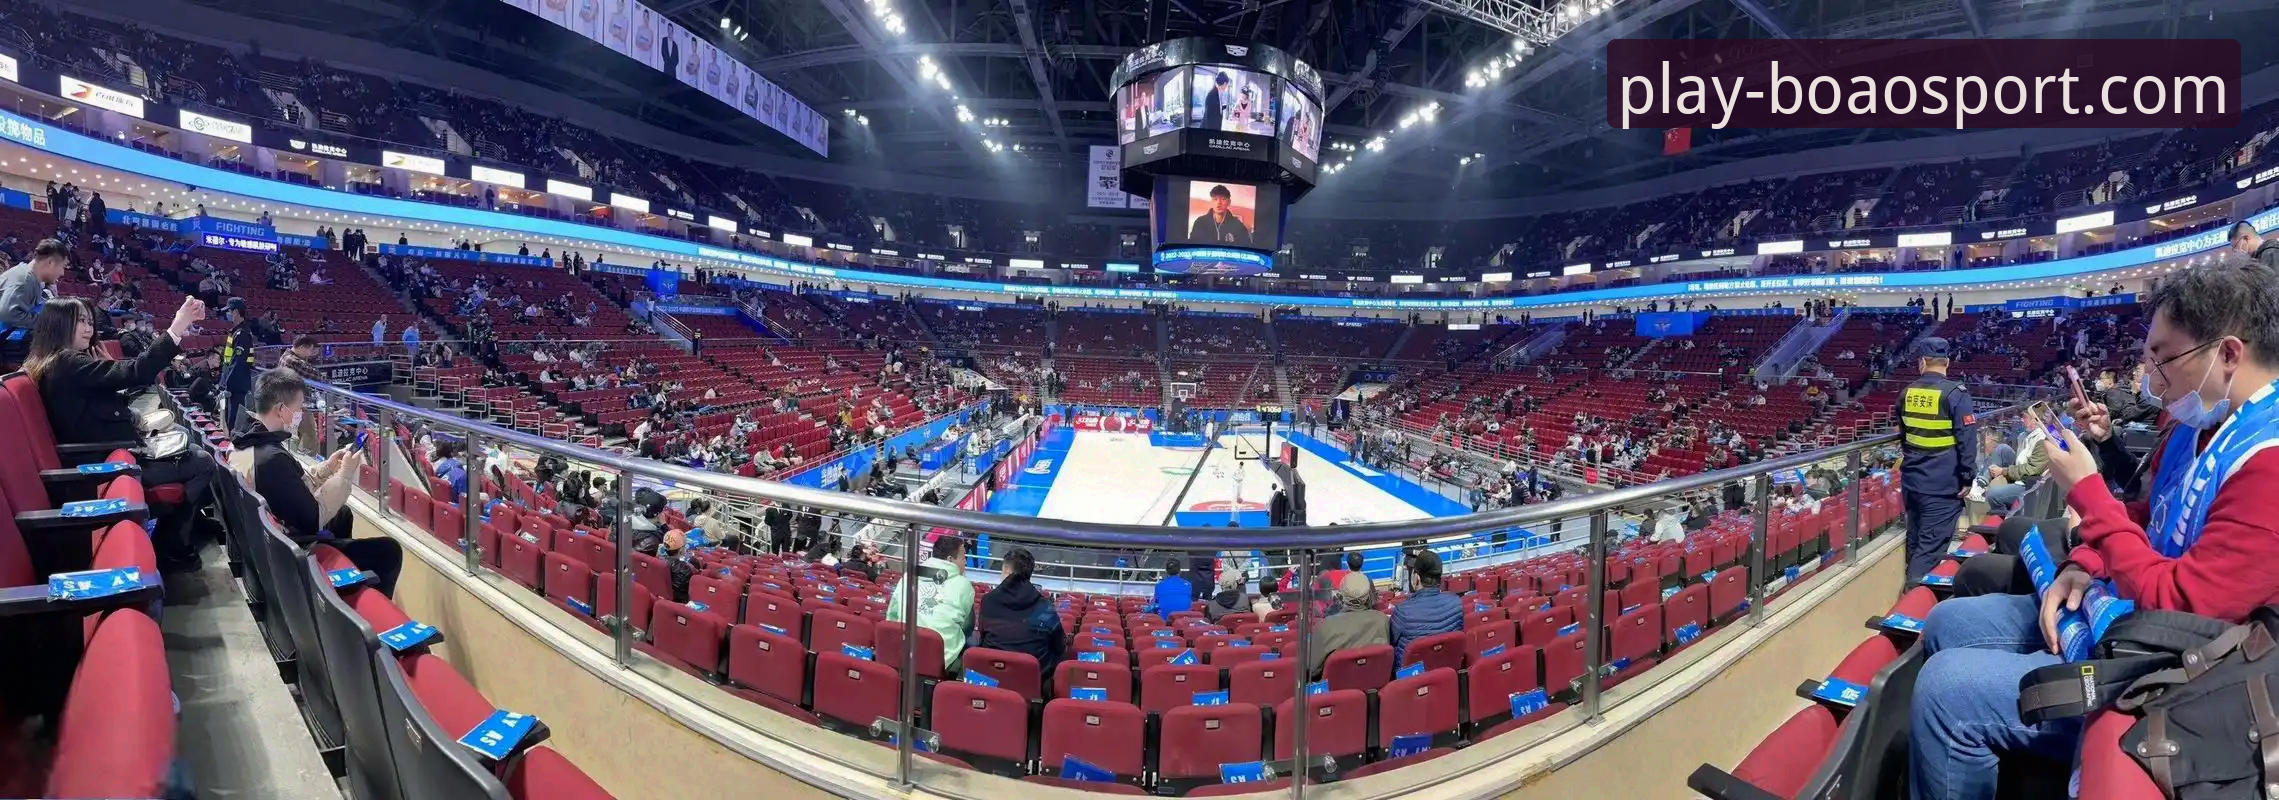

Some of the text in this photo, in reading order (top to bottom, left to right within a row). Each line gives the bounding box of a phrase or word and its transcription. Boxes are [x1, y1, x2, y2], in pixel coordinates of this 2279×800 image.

[216, 220, 265, 237] FIGHTING
[2015, 300, 2054, 310] FIGHTING
[2083, 675, 2093, 707] GEOGRAPHIC
[2088, 674, 2097, 701] NATIONAL
